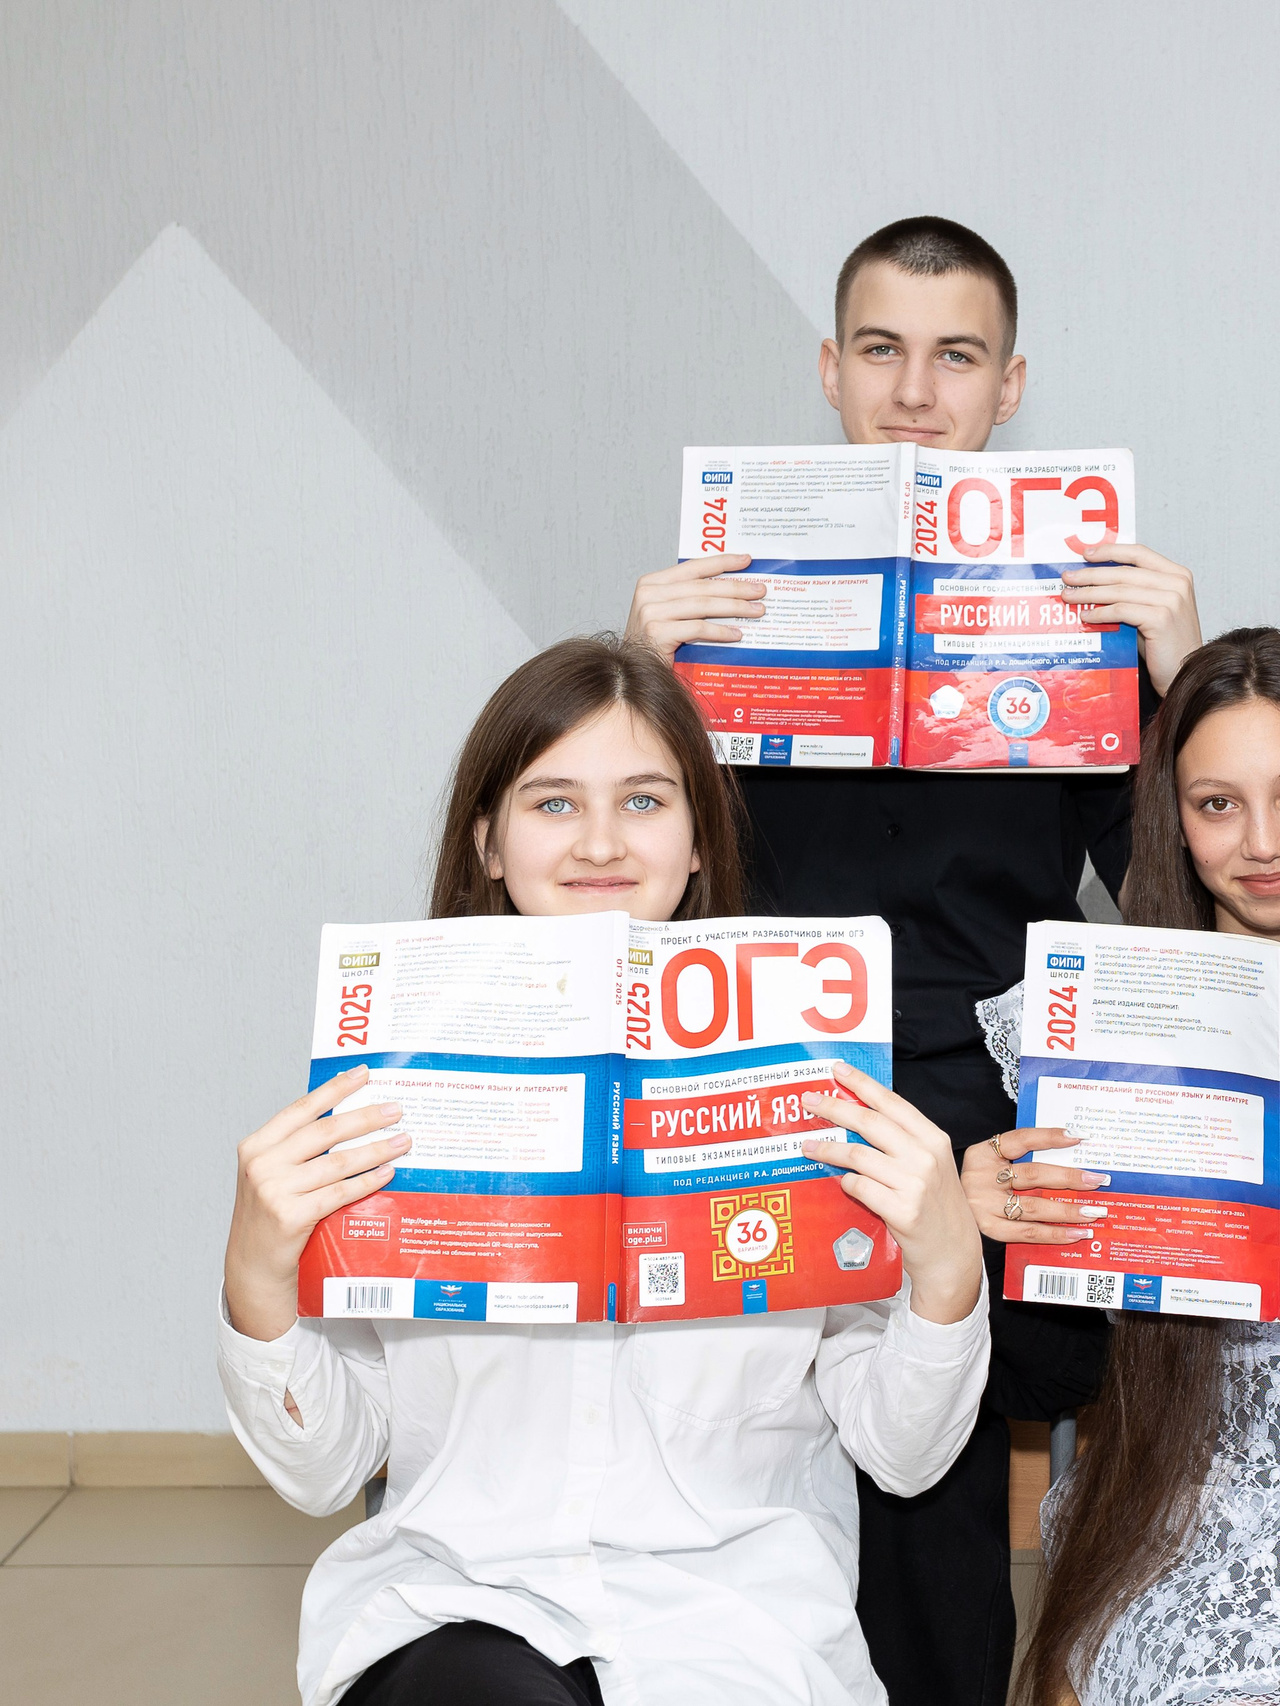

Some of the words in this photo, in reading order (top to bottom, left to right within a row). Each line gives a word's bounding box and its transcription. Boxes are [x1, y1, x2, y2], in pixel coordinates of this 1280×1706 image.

[704, 473, 731, 483] ФИПИ
[1025, 465, 1081, 473] РАЗРАБОТЧИКОВ
[702, 498, 727, 552] 2024
[916, 500, 937, 556] 2024
[948, 476, 1119, 558] ОГЭ
[898, 579, 906, 619] РУССКИЙ
[941, 601, 1029, 627] РУССКИЙ
[896, 621, 904, 645] ЯЗЫК
[1009, 658, 1052, 666] ДОЩИНСКОГО,
[1006, 696, 1031, 714] 36
[661, 935, 692, 946] ПРОЕКТ
[706, 931, 748, 941] УЧАСТИЕМ
[753, 929, 821, 938] РАЗРАБОТЧИКОВ
[826, 930, 844, 938] КИМ
[849, 929, 864, 937] ОГЭ
[342, 954, 376, 966] ФИПИ
[1050, 955, 1083, 969] ФИПИ
[342, 969, 374, 977] ШКОЛЕ
[661, 943, 868, 1049] ОГЭ
[337, 984, 372, 1047] 2025
[626, 982, 651, 1051] 2025
[1047, 985, 1077, 1051] 2024
[650, 1083, 700, 1094] ОСНОВНОЙ
[704, 1070, 789, 1090] ГОСУДАРСТВЕННЫЙ
[612, 1082, 620, 1132] РУССКИЙ
[651, 1095, 761, 1138] РУССКИЙ
[772, 1089, 840, 1125] ЯЗ
[656, 1154, 696, 1165] ТИПОВЫЕ
[702, 1142, 788, 1161] ЭКЗАМЕНАЦИОННЫЕ
[673, 1178, 692, 1187] ПОД
[696, 1172, 750, 1184] РЕДАКЦИЕЙ
[771, 1162, 823, 1177] ДОЩИНСКОГО
[349, 1229, 385, 1238] oge.plus
[401, 1217, 447, 1226] http://oge.plus
[628, 1226, 662, 1235] включи
[737, 1220, 768, 1244] 36
[628, 1235, 662, 1246] oge.plus
